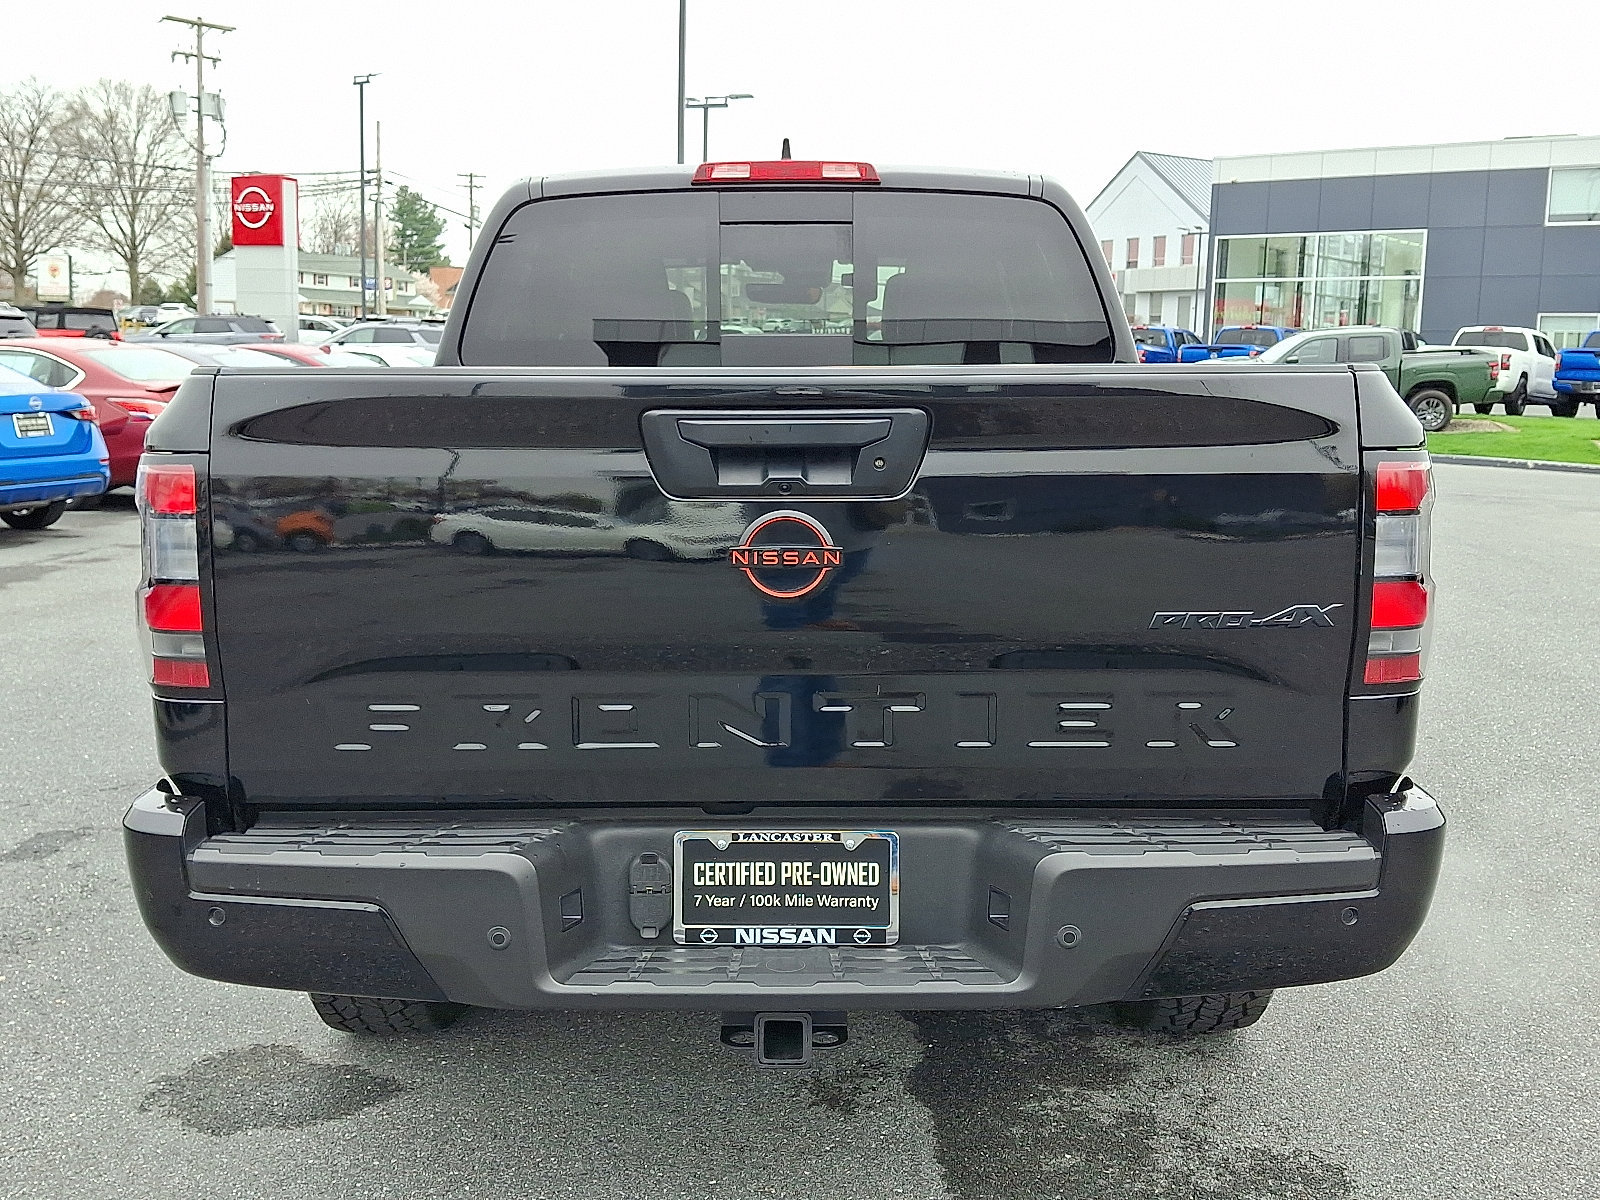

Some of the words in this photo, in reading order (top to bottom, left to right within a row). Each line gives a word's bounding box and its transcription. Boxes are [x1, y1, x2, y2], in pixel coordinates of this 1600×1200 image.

[233, 203, 274, 212] NISSAN
[732, 550, 840, 565] NISSAN
[1148, 603, 1344, 629] PRO-4X
[333, 692, 1238, 751] FRONTIER
[737, 832, 835, 842] LANCASTER
[693, 861, 776, 886] CERTIFIED
[780, 861, 880, 886] PRE-OWNED
[694, 895, 702, 907] 7
[705, 895, 736, 907] Year
[739, 895, 746, 908] /
[750, 894, 782, 907] 100k
[785, 894, 814, 907] Mile
[817, 895, 880, 910] Warranty
[735, 928, 836, 944] NISSAN
